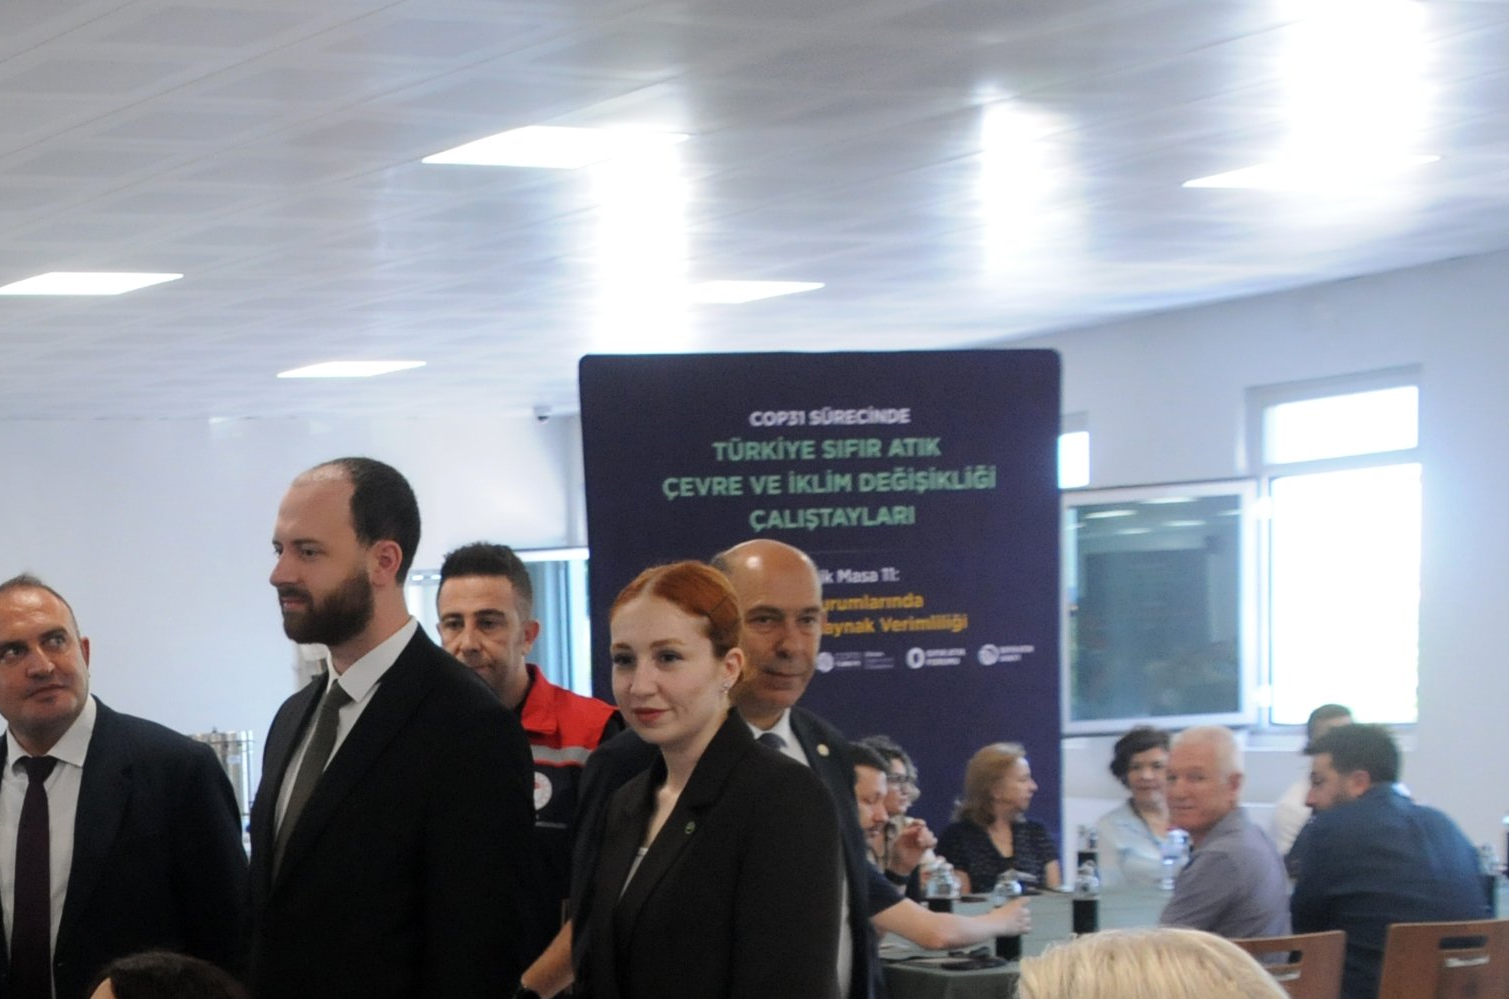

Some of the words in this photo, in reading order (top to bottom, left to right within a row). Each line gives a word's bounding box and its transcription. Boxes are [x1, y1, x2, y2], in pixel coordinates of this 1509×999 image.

[749, 411, 807, 428] COP31
[809, 406, 911, 426] SÜRECİNDE
[713, 438, 817, 462] TÜRKİYE
[822, 439, 883, 460] SIFIR
[888, 438, 943, 458] ATIK
[662, 477, 744, 500] ÇEVRE
[750, 476, 782, 496] VE
[789, 470, 853, 494] İKLİM
[859, 465, 998, 494] DEĞİŞİKLİĞİ
[749, 506, 917, 532] ÇALIŞTAYLARI
[836, 568, 879, 584] Masa
[822, 593, 925, 612] urumlarında
